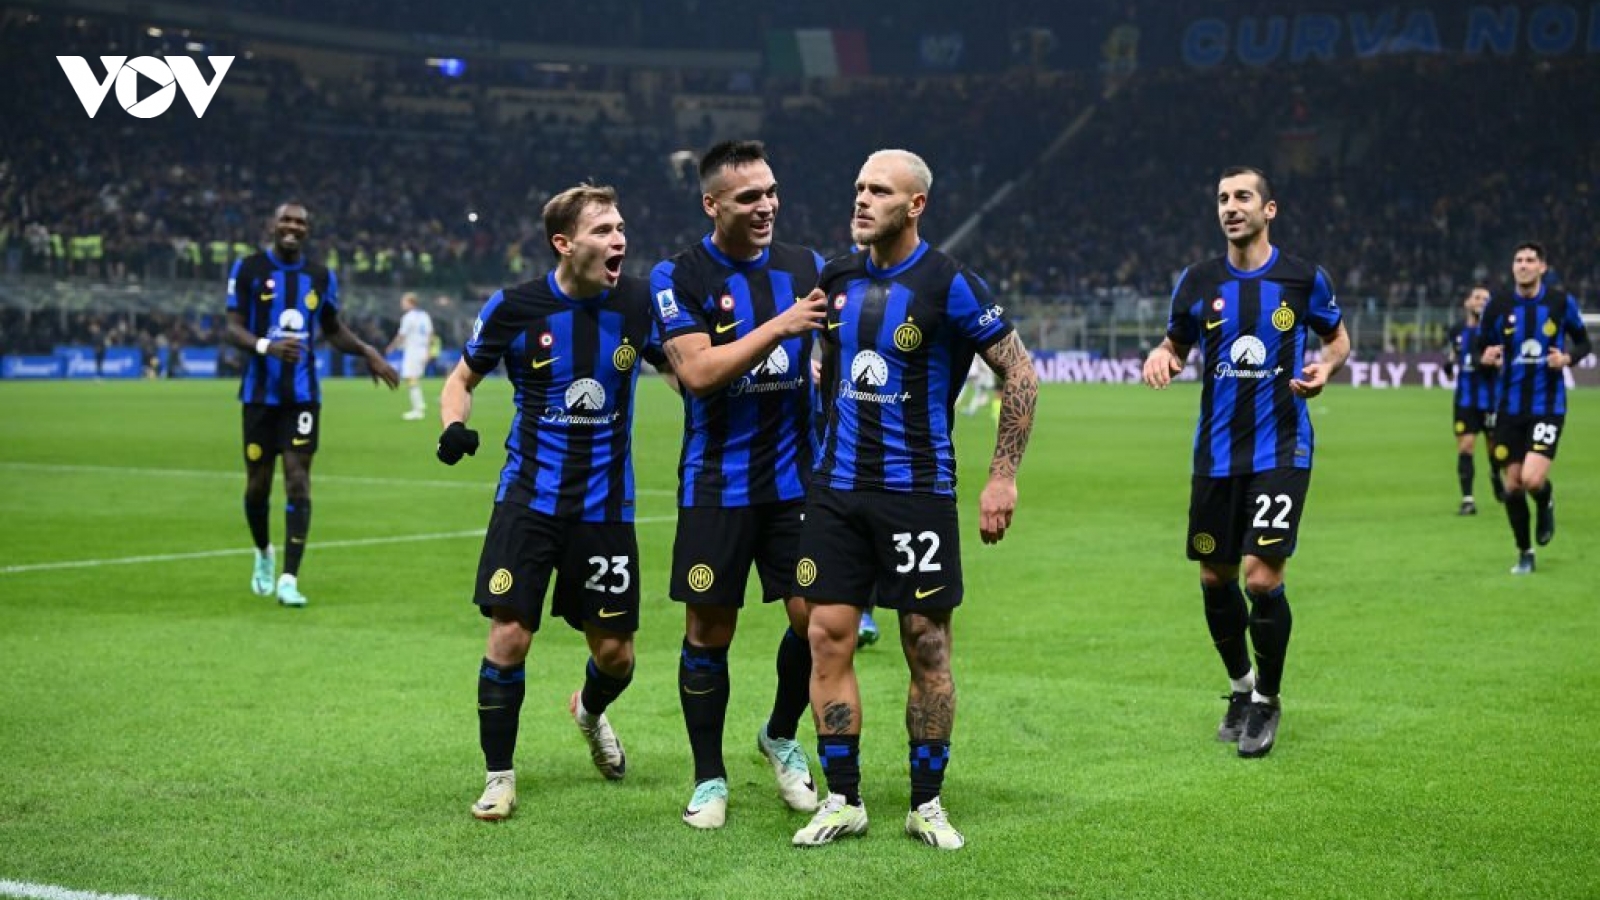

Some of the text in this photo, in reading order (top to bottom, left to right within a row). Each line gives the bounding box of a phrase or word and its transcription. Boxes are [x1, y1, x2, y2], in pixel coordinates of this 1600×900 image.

[1181, 5, 1600, 67] CURVA NO
[1350, 362, 1407, 389] FLY
[297, 411, 313, 435] 9
[1533, 422, 1558, 444] 95
[1253, 494, 1292, 529] 22
[892, 530, 942, 573] 32
[585, 555, 630, 594] 23
